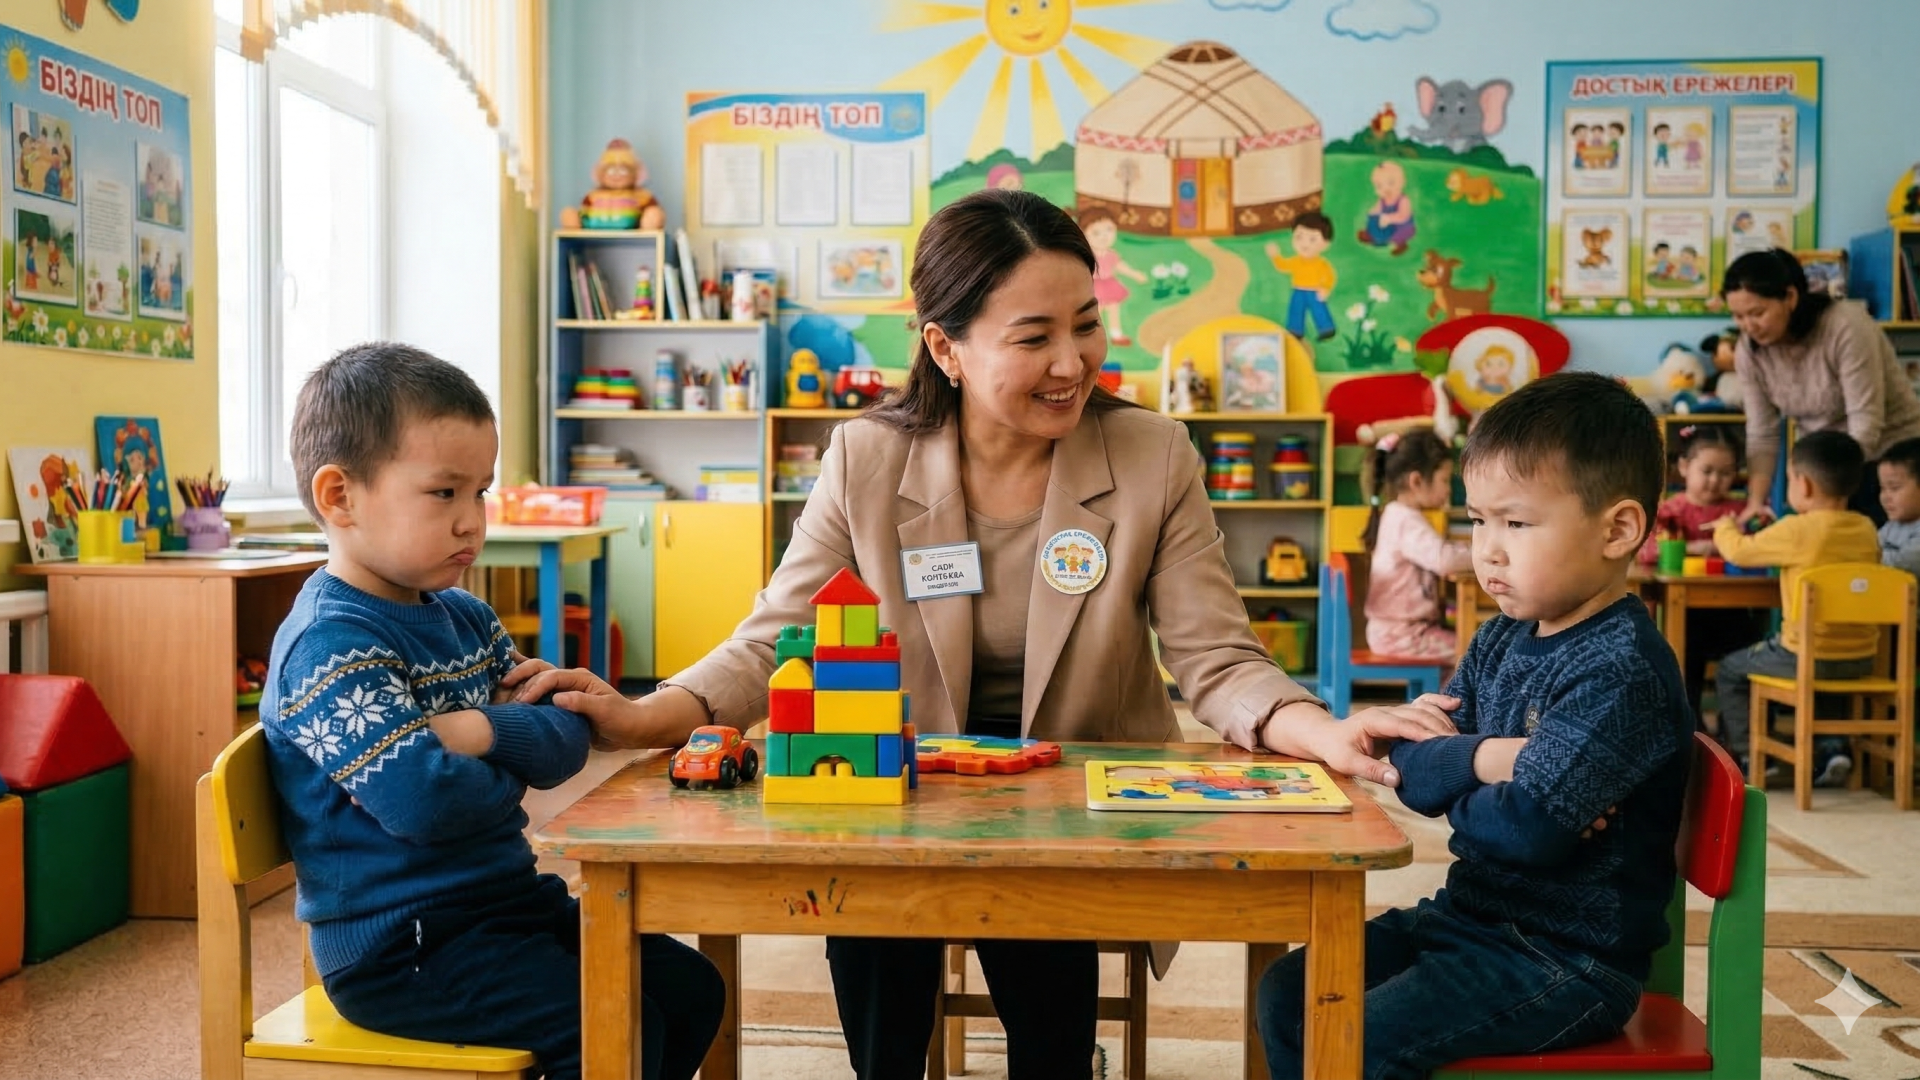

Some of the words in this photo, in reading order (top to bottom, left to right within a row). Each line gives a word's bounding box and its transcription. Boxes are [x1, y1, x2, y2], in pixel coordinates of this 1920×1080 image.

[40, 58, 119, 121] БІЗДІҢ
[122, 88, 161, 131] ТОП
[1572, 76, 1668, 98] ДОСТЫҚ
[733, 104, 822, 128] БІЗДІҢ
[829, 104, 881, 126] ТОП
